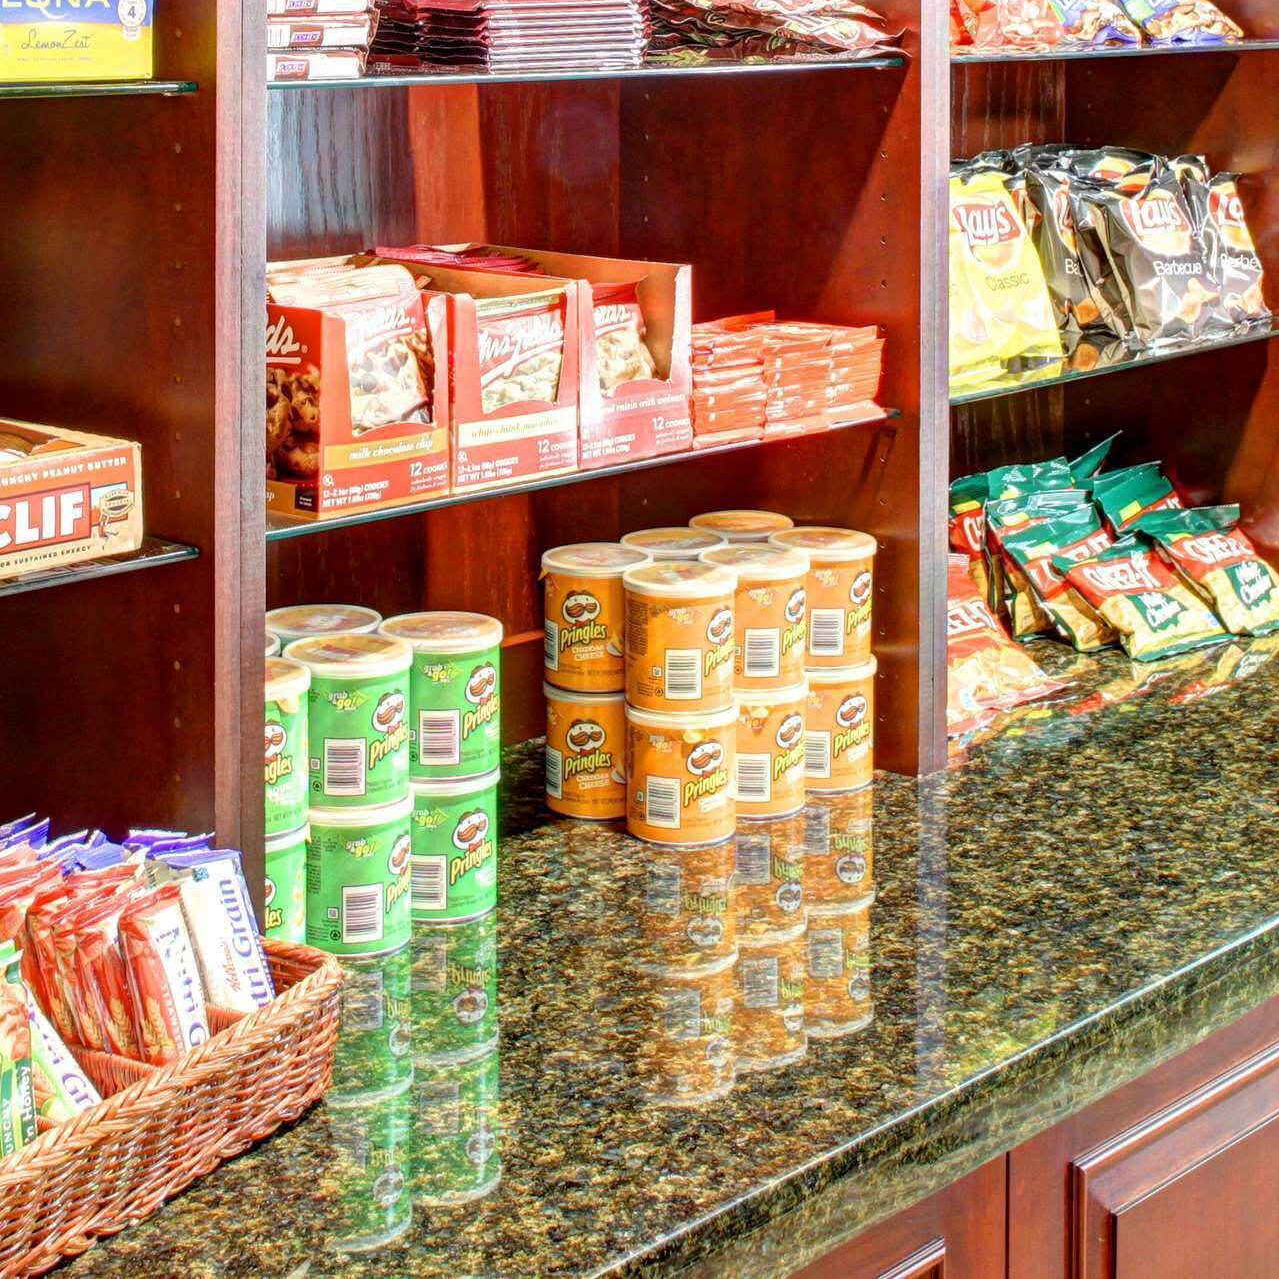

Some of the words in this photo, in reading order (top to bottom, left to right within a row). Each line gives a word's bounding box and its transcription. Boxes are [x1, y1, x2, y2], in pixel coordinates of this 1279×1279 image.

[126, 5, 138, 19] 4
[958, 200, 1016, 248] Lay's
[1133, 197, 1188, 235] Lay's
[985, 269, 1031, 293] Classic
[1152, 259, 1203, 277] Barbecue
[651, 416, 665, 430] 12
[348, 448, 371, 462] milk
[372, 441, 415, 458] chocolate
[415, 434, 434, 452] chip
[537, 439, 550, 454] 12
[42, 464, 84, 480] PEANUT
[87, 456, 129, 472] BUTTER
[408, 461, 423, 477] 12
[13, 551, 58, 566] SUSTAINED
[60, 545, 92, 557] ENERGY
[560, 619, 608, 653] Pringles
[574, 650, 606, 662] CHEESE
[462, 694, 500, 741] Pringles
[833, 720, 871, 759] Pringles
[563, 749, 613, 781] Pringles
[683, 767, 729, 808] Pringles
[450, 838, 493, 885] Pringles
[217, 877, 253, 959] Grain
[19, 1065, 34, 1121] Honey
